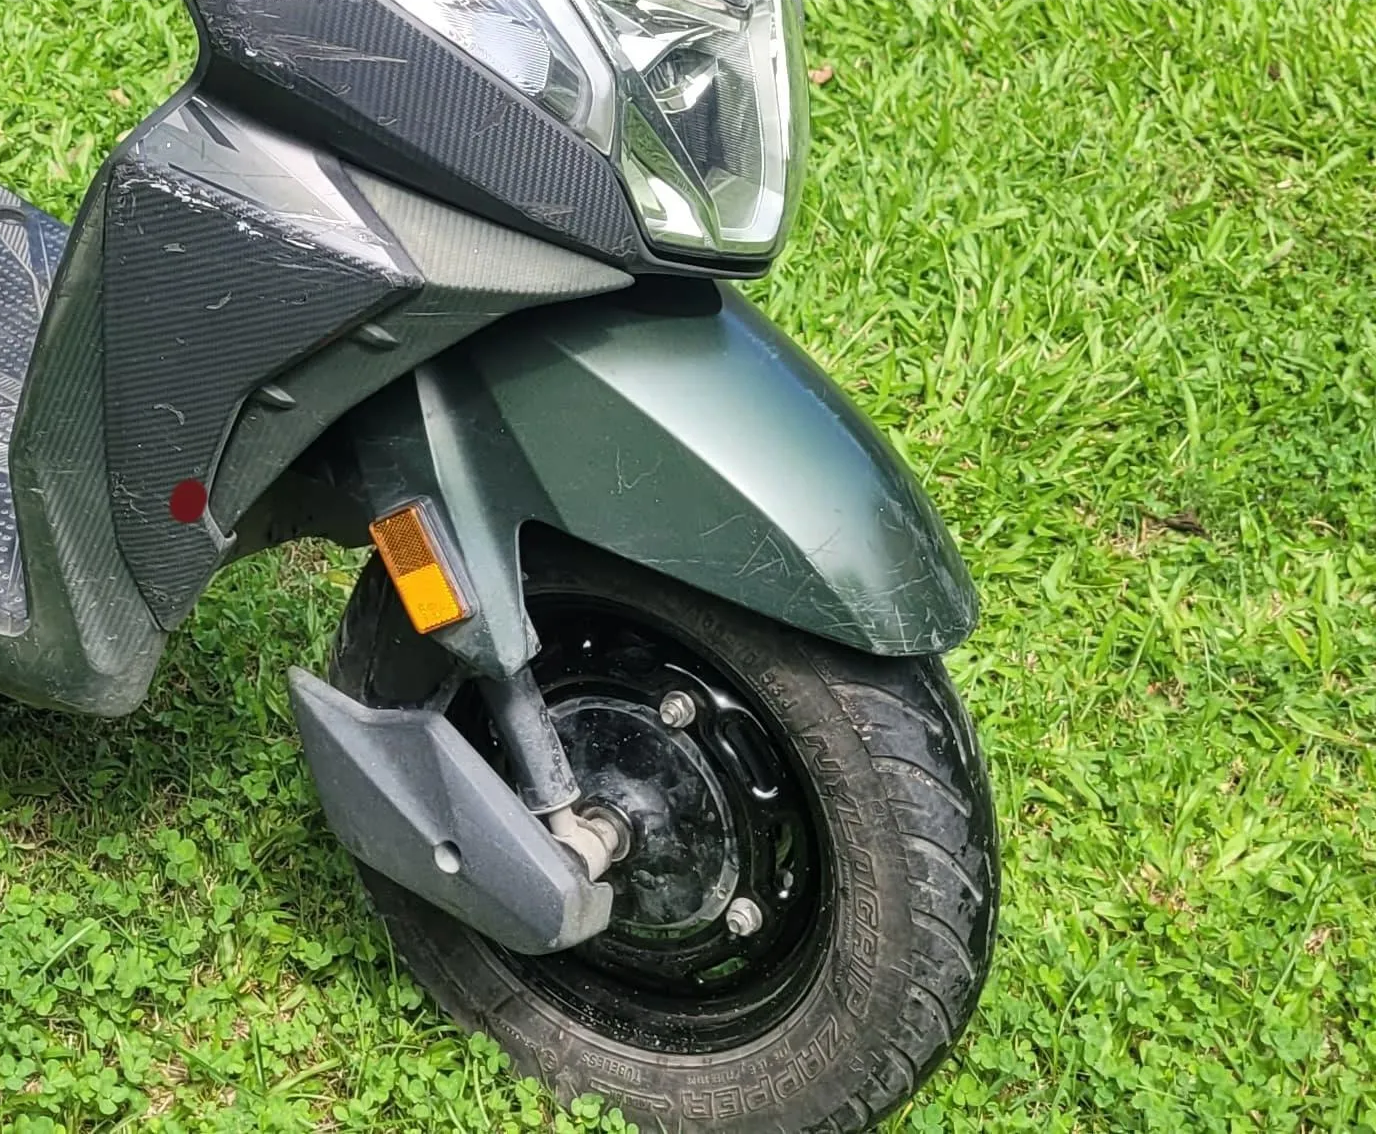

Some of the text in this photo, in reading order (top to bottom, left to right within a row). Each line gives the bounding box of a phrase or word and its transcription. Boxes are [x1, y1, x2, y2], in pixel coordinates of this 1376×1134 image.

[802, 734, 880, 1020] NYLOGRIP
[582, 1051, 642, 1085] TUBELESS
[682, 1014, 839, 1120] ZAPPER
